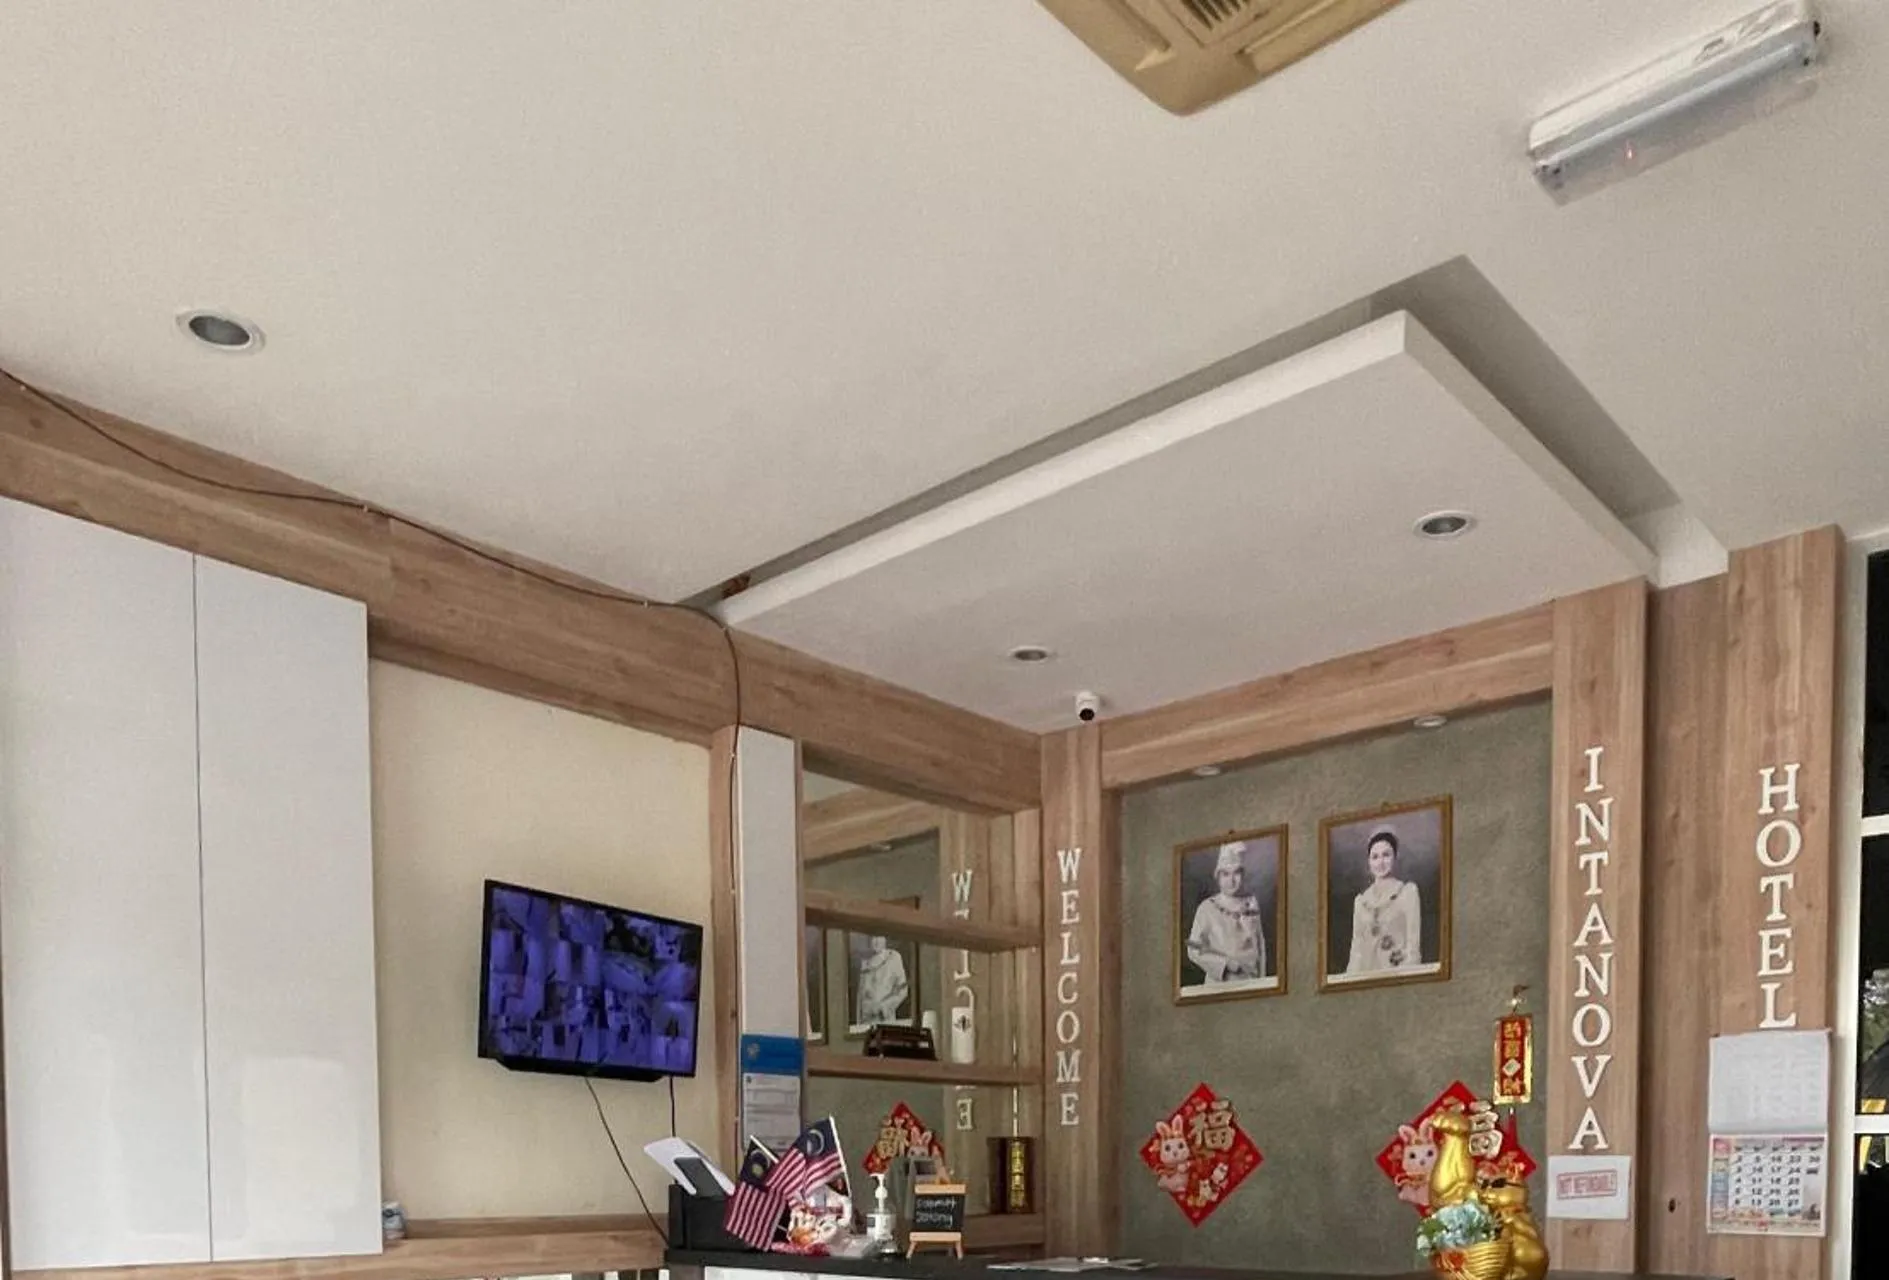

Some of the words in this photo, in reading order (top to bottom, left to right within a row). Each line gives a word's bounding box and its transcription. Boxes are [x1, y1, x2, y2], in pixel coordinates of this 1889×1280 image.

[1056, 848, 1082, 1126] WELCOME
[1570, 747, 1614, 1150] INTANOVA
[1756, 763, 1802, 1029] HOTEL
[1188, 1098, 1236, 1150] 福
